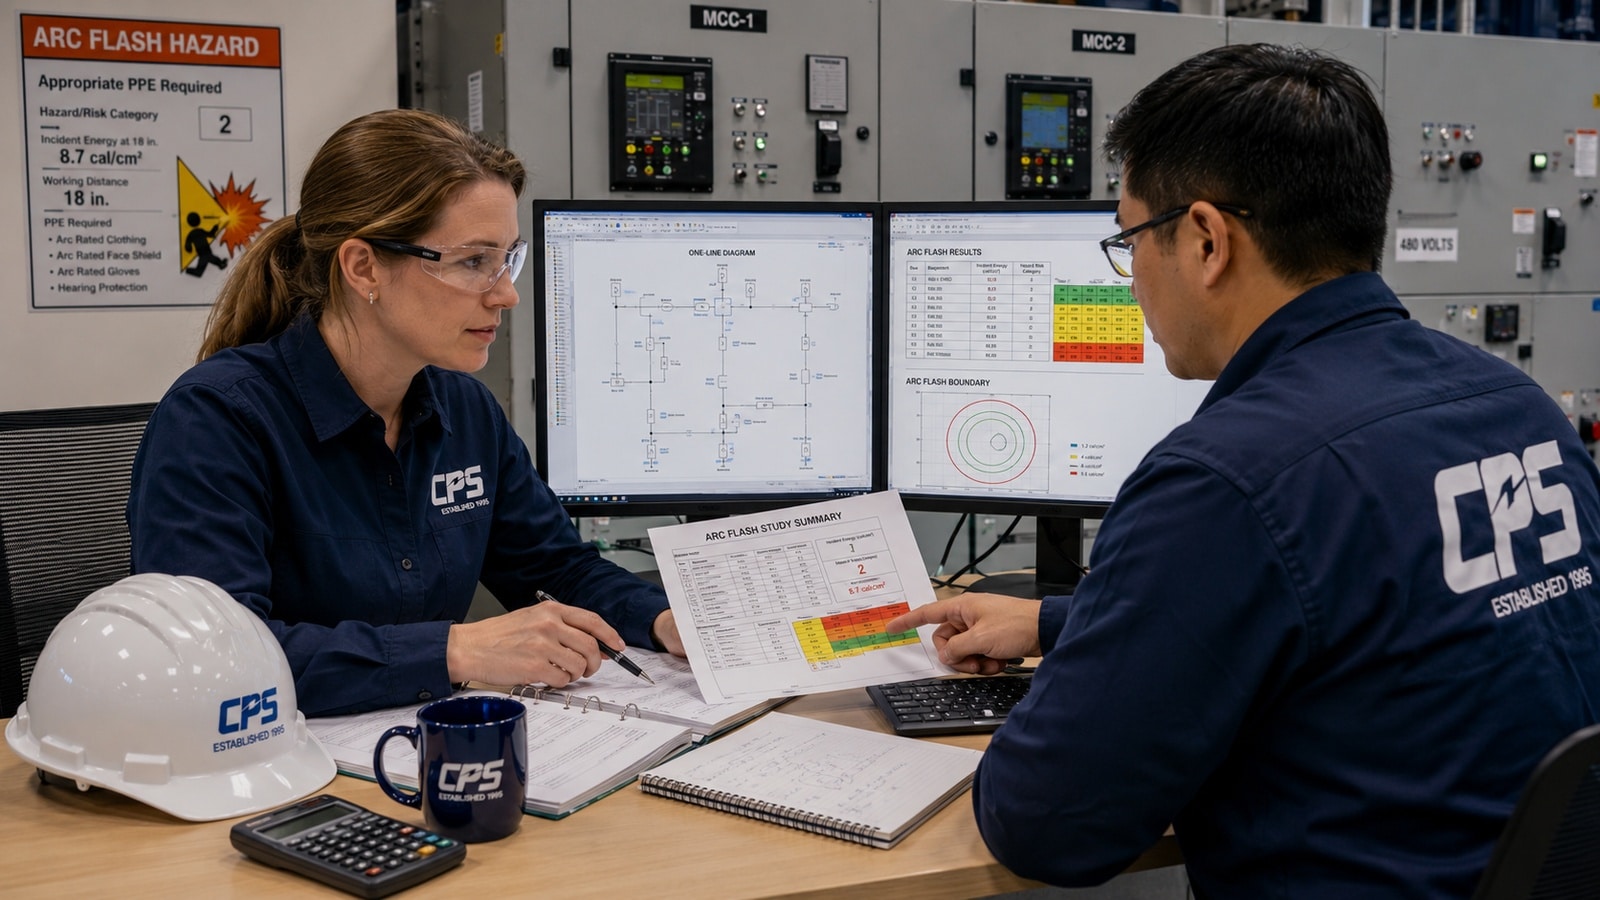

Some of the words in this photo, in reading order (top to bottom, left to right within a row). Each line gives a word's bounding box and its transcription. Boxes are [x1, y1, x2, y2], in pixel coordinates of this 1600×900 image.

[703, 10, 754, 28] MCC-1
[33, 27, 82, 48] ARC
[89, 29, 162, 52] FLASH
[169, 33, 259, 57] HAZARD
[1082, 34, 1126, 50] MCC-2
[38, 75, 124, 91] Appropriate
[128, 78, 157, 91] PPE
[160, 80, 222, 95] Required
[40, 106, 107, 119] Hazard/Risk
[110, 109, 159, 122] Category
[219, 115, 232, 134] 2
[41, 135, 81, 144] Incident
[84, 136, 118, 147] Energy
[120, 138, 130, 146] at
[133, 137, 144, 146] 18
[147, 137, 158, 146] in.
[60, 149, 85, 164] 8.7
[42, 176, 84, 187] Working
[86, 177, 129, 186] Distance
[64, 190, 85, 206] 18
[90, 191, 110, 206] in.
[44, 218, 65, 227] PPE
[67, 218, 112, 228] Required
[56, 235, 73, 244] Arc
[75, 235, 104, 244] Rated
[106, 235, 147, 246] Clothing
[1400, 237, 1419, 252] 480
[1422, 237, 1454, 252] VOLTS
[56, 251, 73, 260] Arc
[76, 251, 105, 260] Rated
[107, 251, 130, 260] Face
[132, 251, 162, 260] Shield
[688, 249, 721, 257] ONE-LINE
[722, 249, 756, 257] DIAGRAM
[907, 248, 923, 256] ARC
[924, 248, 948, 256] FLASH
[949, 248, 982, 257] RESULTS
[57, 267, 74, 276] Arc
[76, 267, 105, 276] Rated
[107, 267, 140, 276] Gloves
[57, 283, 96, 294] Hearing
[98, 283, 148, 293] Protection
[906, 378, 922, 386] ARC
[923, 378, 947, 386] FLASH
[948, 378, 990, 387] BOUNDARY
[431, 465, 484, 506] CPS
[1434, 439, 1582, 594] CPS
[705, 529, 726, 542] ARC
[727, 525, 759, 538] FLASH
[760, 520, 792, 533] STUDY
[794, 512, 842, 528] SUMMARY
[857, 564, 867, 575] 2
[1491, 575, 1568, 618] ESTABLISHED
[218, 687, 278, 735] CPS
[213, 730, 270, 753] ESTABLISHED
[438, 759, 504, 792] CPS
